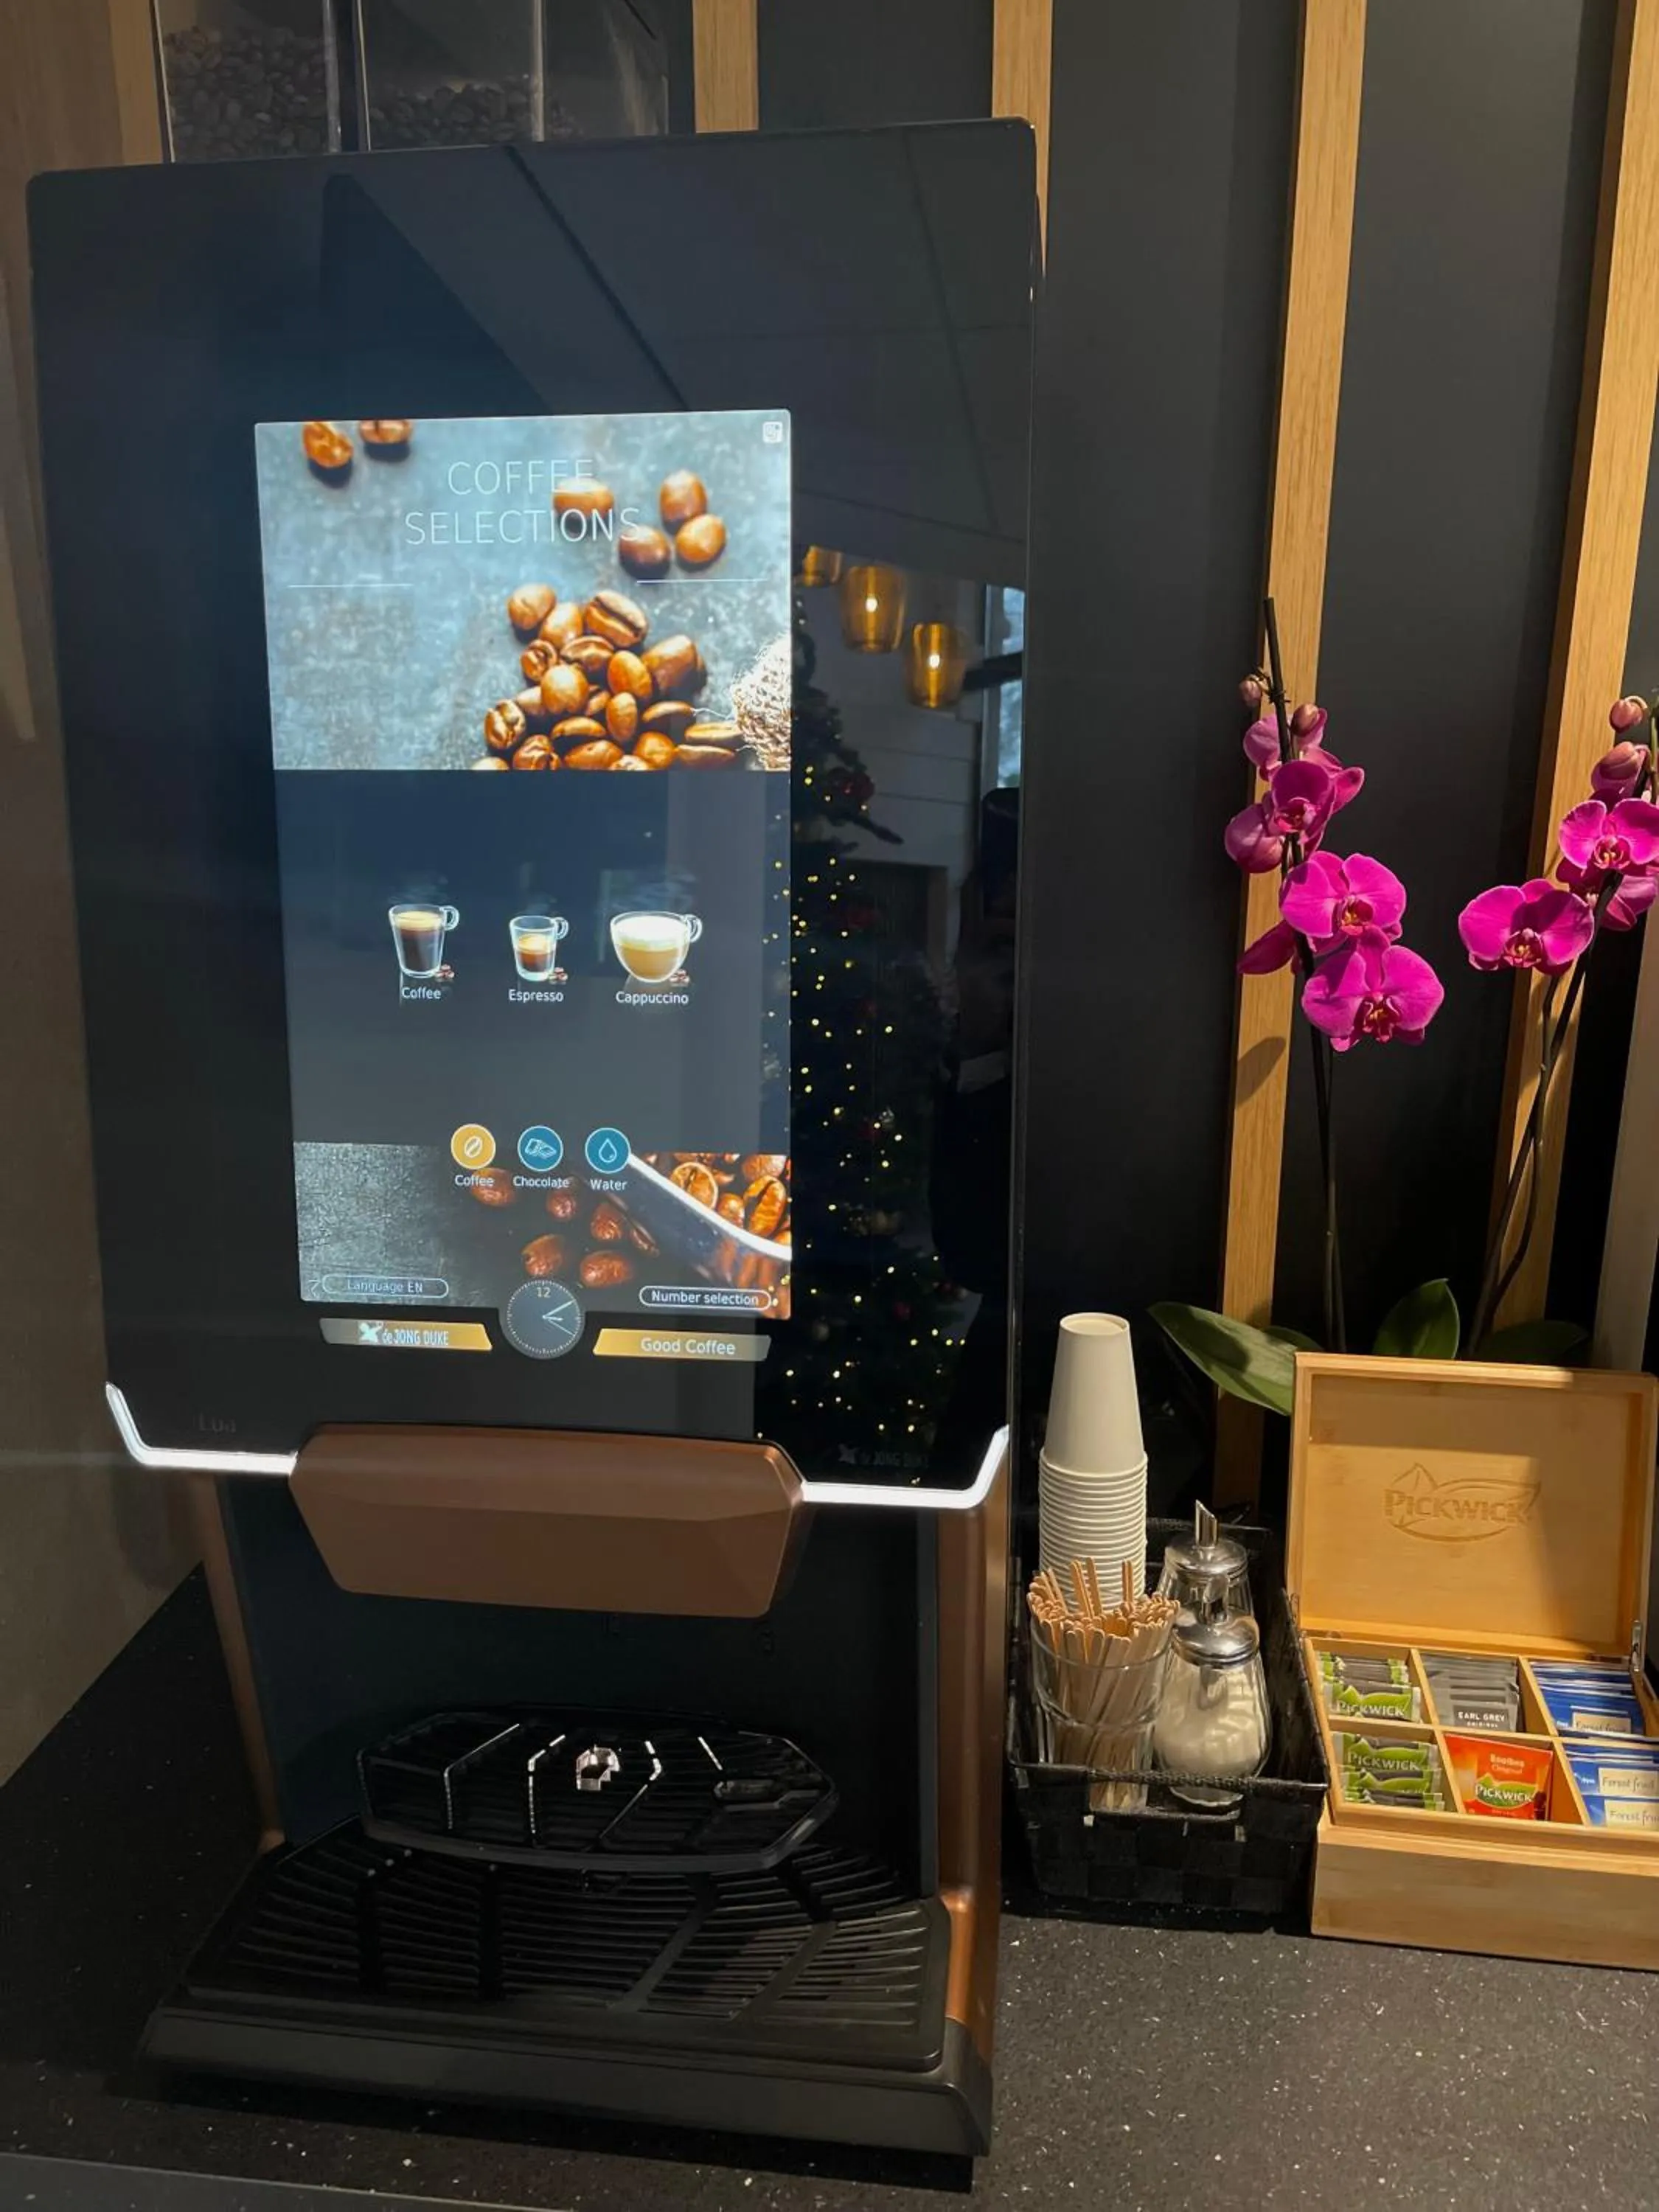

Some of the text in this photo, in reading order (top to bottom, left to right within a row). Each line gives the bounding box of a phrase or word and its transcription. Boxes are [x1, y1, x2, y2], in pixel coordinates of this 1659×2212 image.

[447, 459, 594, 495] COFFEE
[405, 507, 640, 545] SELECTIONS
[401, 987, 442, 1001] Coffee
[509, 989, 564, 1003] Espresso
[616, 990, 689, 1006] Cappuccino
[454, 1174, 495, 1187] Coffee
[512, 1175, 570, 1189] Chocolate
[591, 1179, 627, 1191] Water
[347, 1281, 423, 1294] Language EN
[536, 1287, 551, 1298] 12
[651, 1290, 759, 1306] Number selection
[392, 1329, 420, 1345] JONG
[641, 1338, 736, 1355] Good Coffee
[1383, 1489, 1528, 1524] PICKWICK
[1458, 1711, 1505, 1722] EARL GREY
[1347, 1751, 1419, 1771] PICKWICK
[1475, 1784, 1532, 1802] PICKWICK
